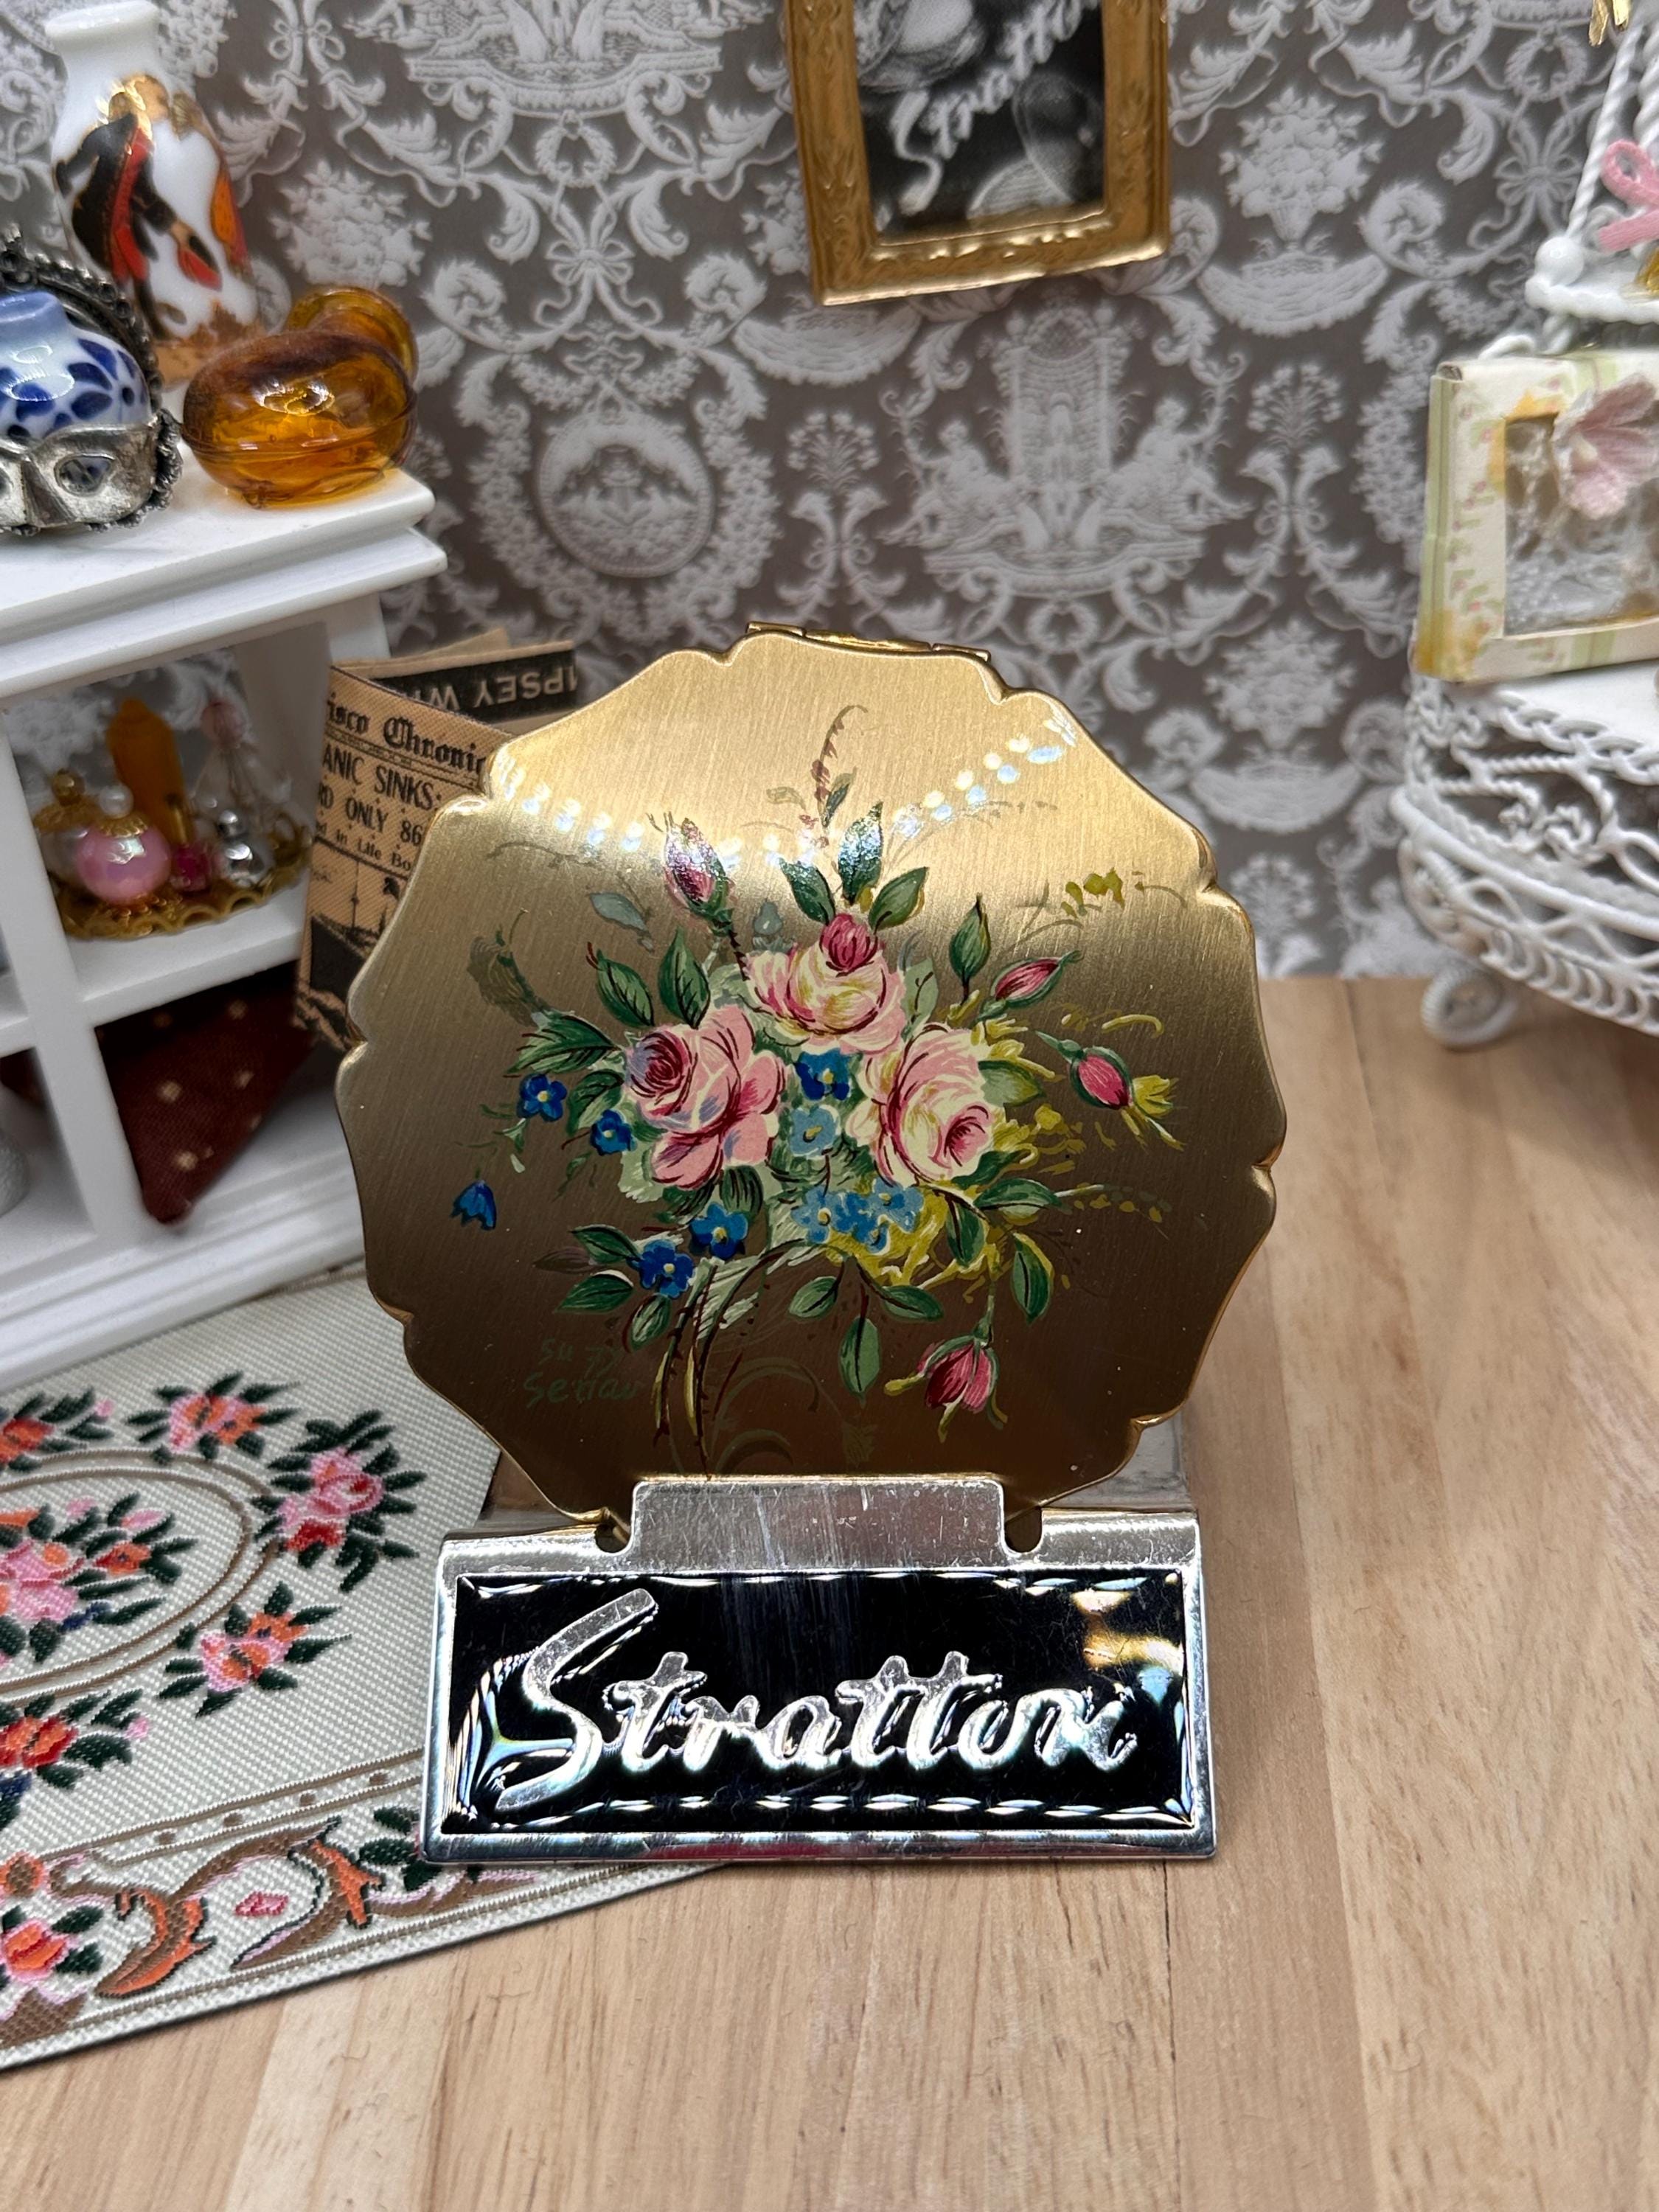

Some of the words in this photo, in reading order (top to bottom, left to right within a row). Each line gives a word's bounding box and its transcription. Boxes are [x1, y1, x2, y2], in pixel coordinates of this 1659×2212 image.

[323, 742, 365, 785] ANIC
[345, 797, 389, 833] ONLY
[400, 820, 423, 847] 86
[494, 1587, 1140, 1812] Stratton
